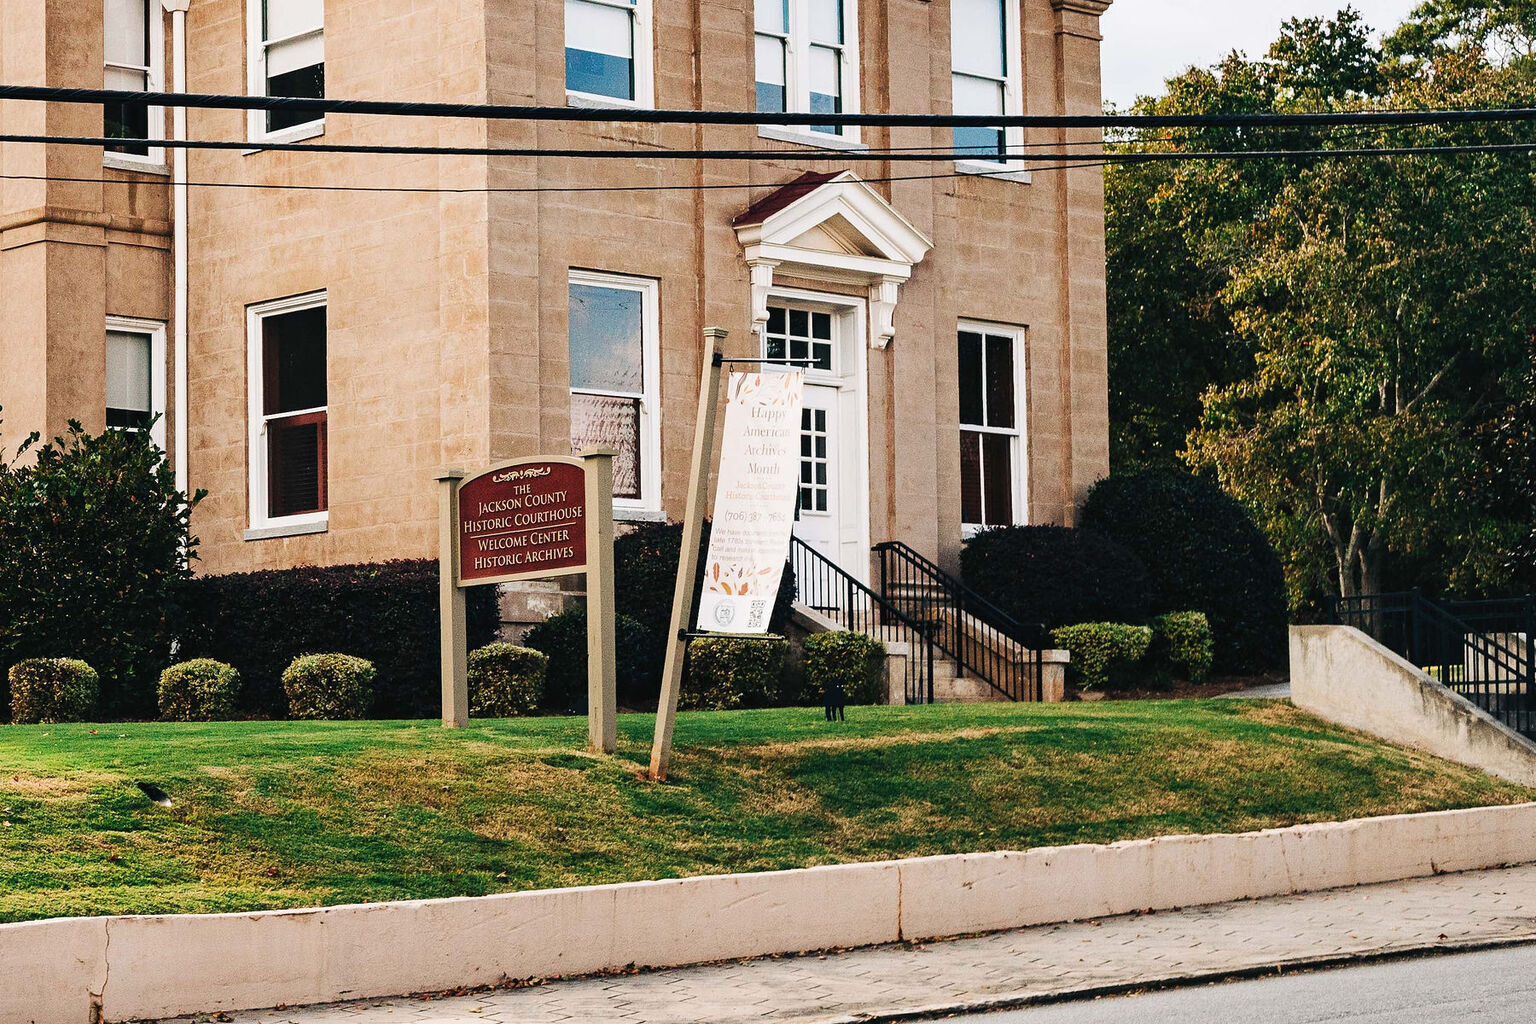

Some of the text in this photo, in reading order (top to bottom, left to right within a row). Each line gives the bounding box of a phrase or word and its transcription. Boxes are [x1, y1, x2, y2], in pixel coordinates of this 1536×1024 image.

[751, 407, 787, 423] Happy
[743, 425, 791, 437] American
[744, 444, 786, 456] Archives
[747, 462, 780, 475] Month
[513, 484, 531, 495] THE
[478, 490, 567, 516] JACKSON COUNTY
[464, 506, 583, 533] HISTORIC COURTHOUSE
[478, 529, 570, 551] WELCOME CENTER
[474, 546, 574, 570] HISTORIC ARCHIVES
